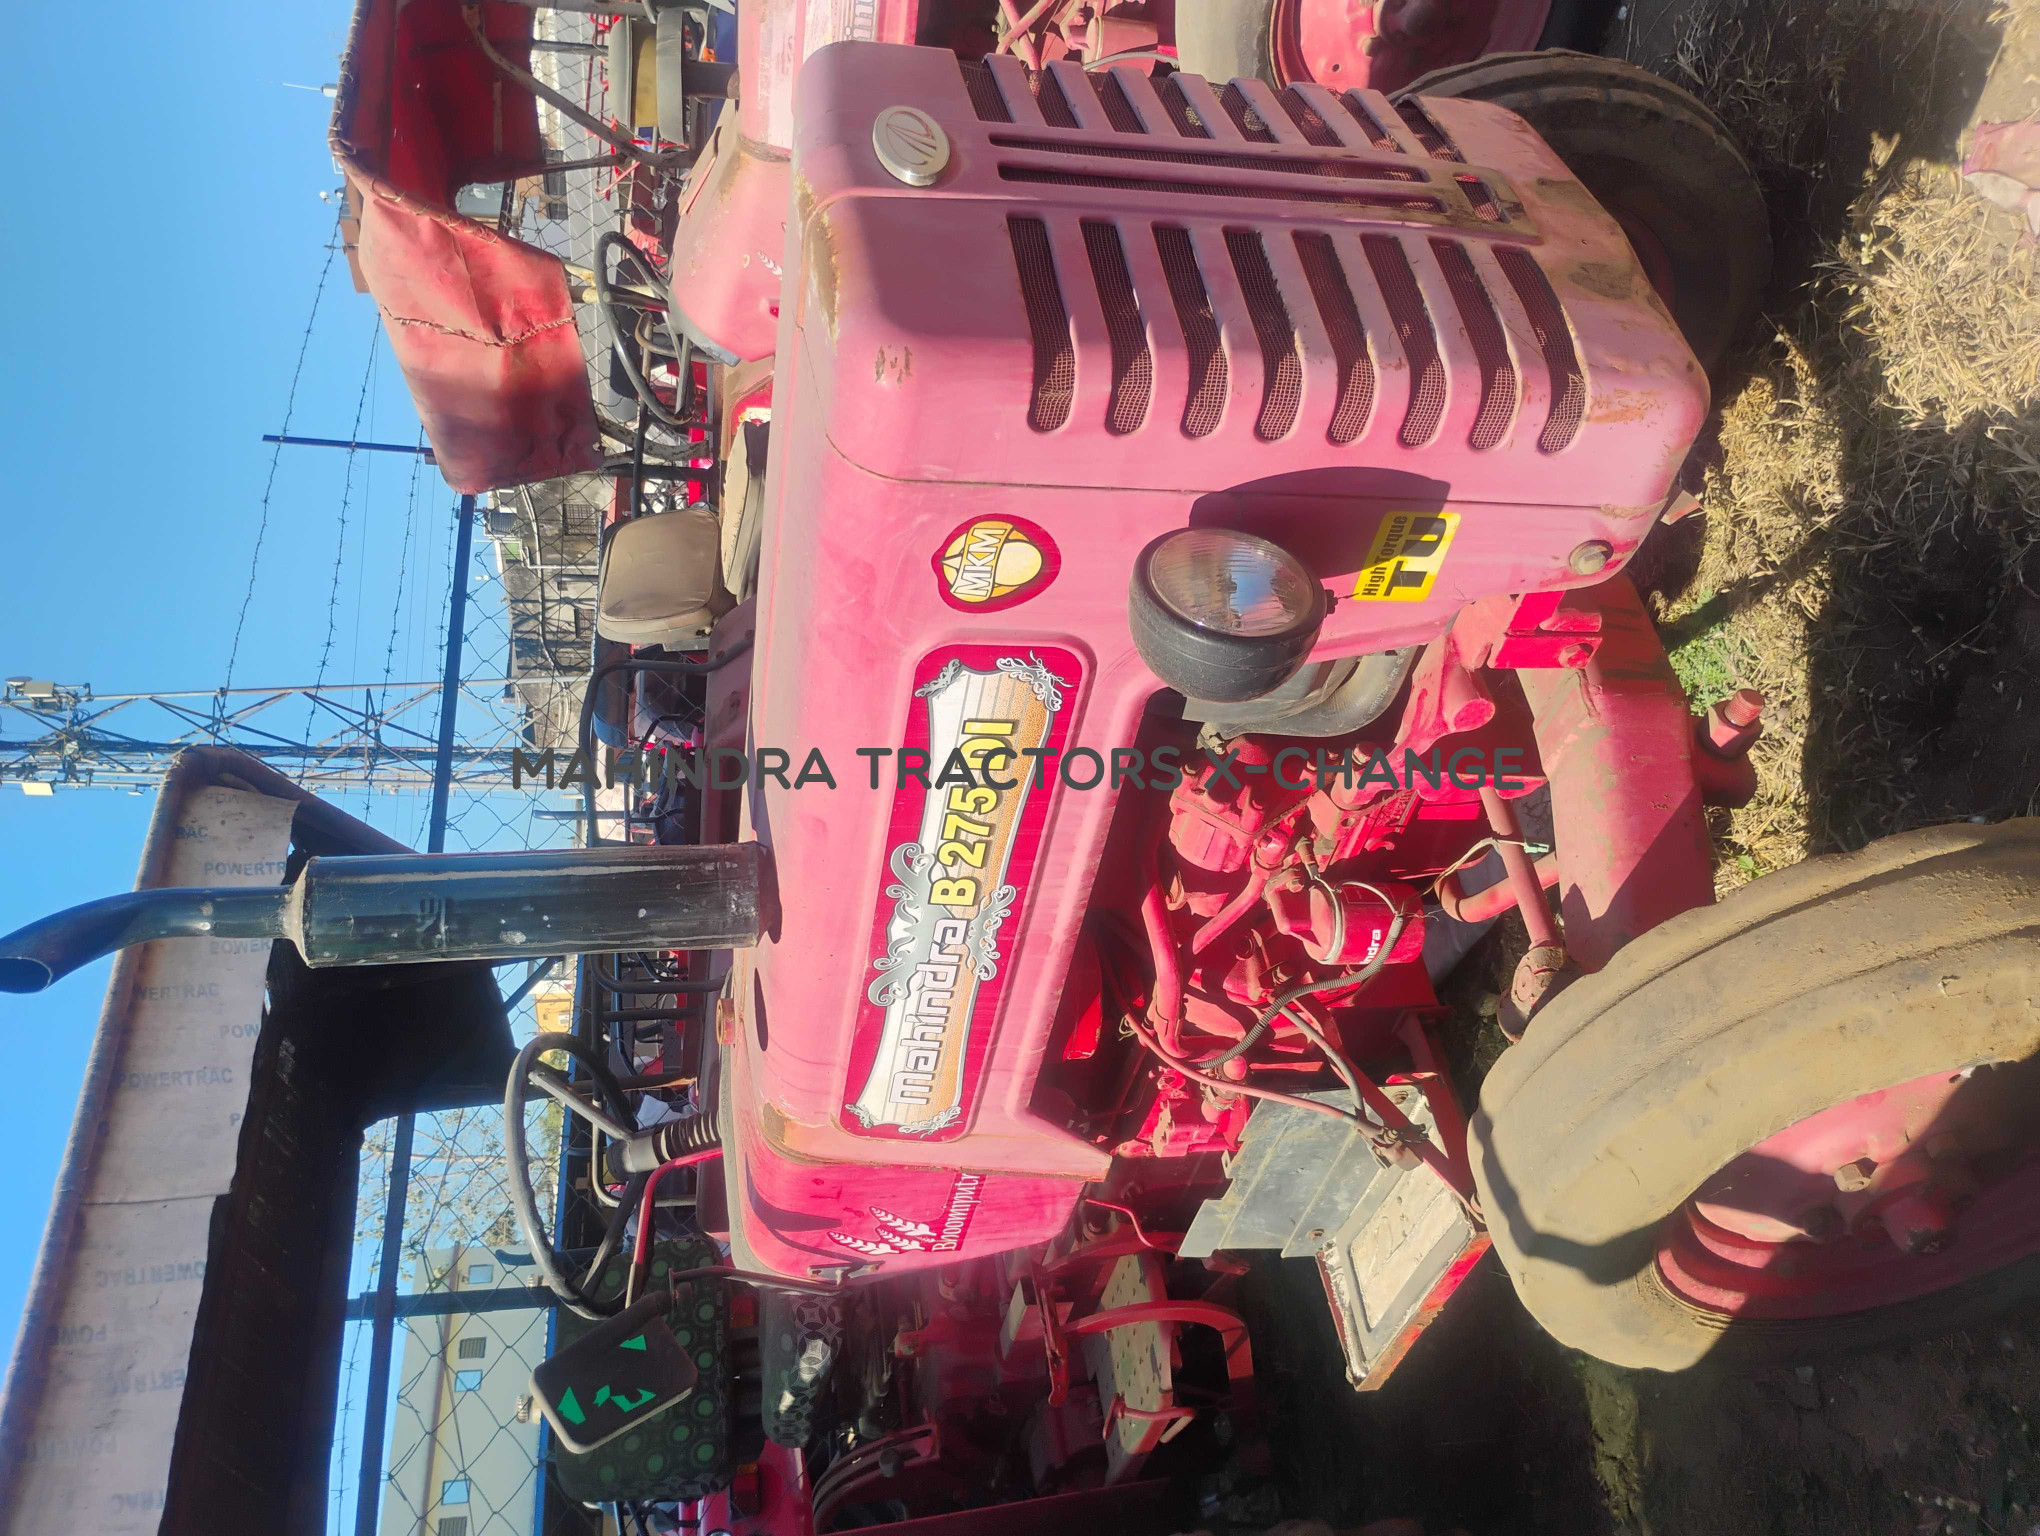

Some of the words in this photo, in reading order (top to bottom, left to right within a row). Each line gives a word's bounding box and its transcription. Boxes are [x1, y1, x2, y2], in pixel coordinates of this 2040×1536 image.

[952, 528, 1008, 597] MKM
[1361, 566, 1387, 596] High
[1374, 516, 1408, 563] Torque
[1383, 517, 1447, 596] TU
[953, 720, 1014, 773] DI
[936, 785, 998, 868] 275
[929, 876, 978, 907] B
